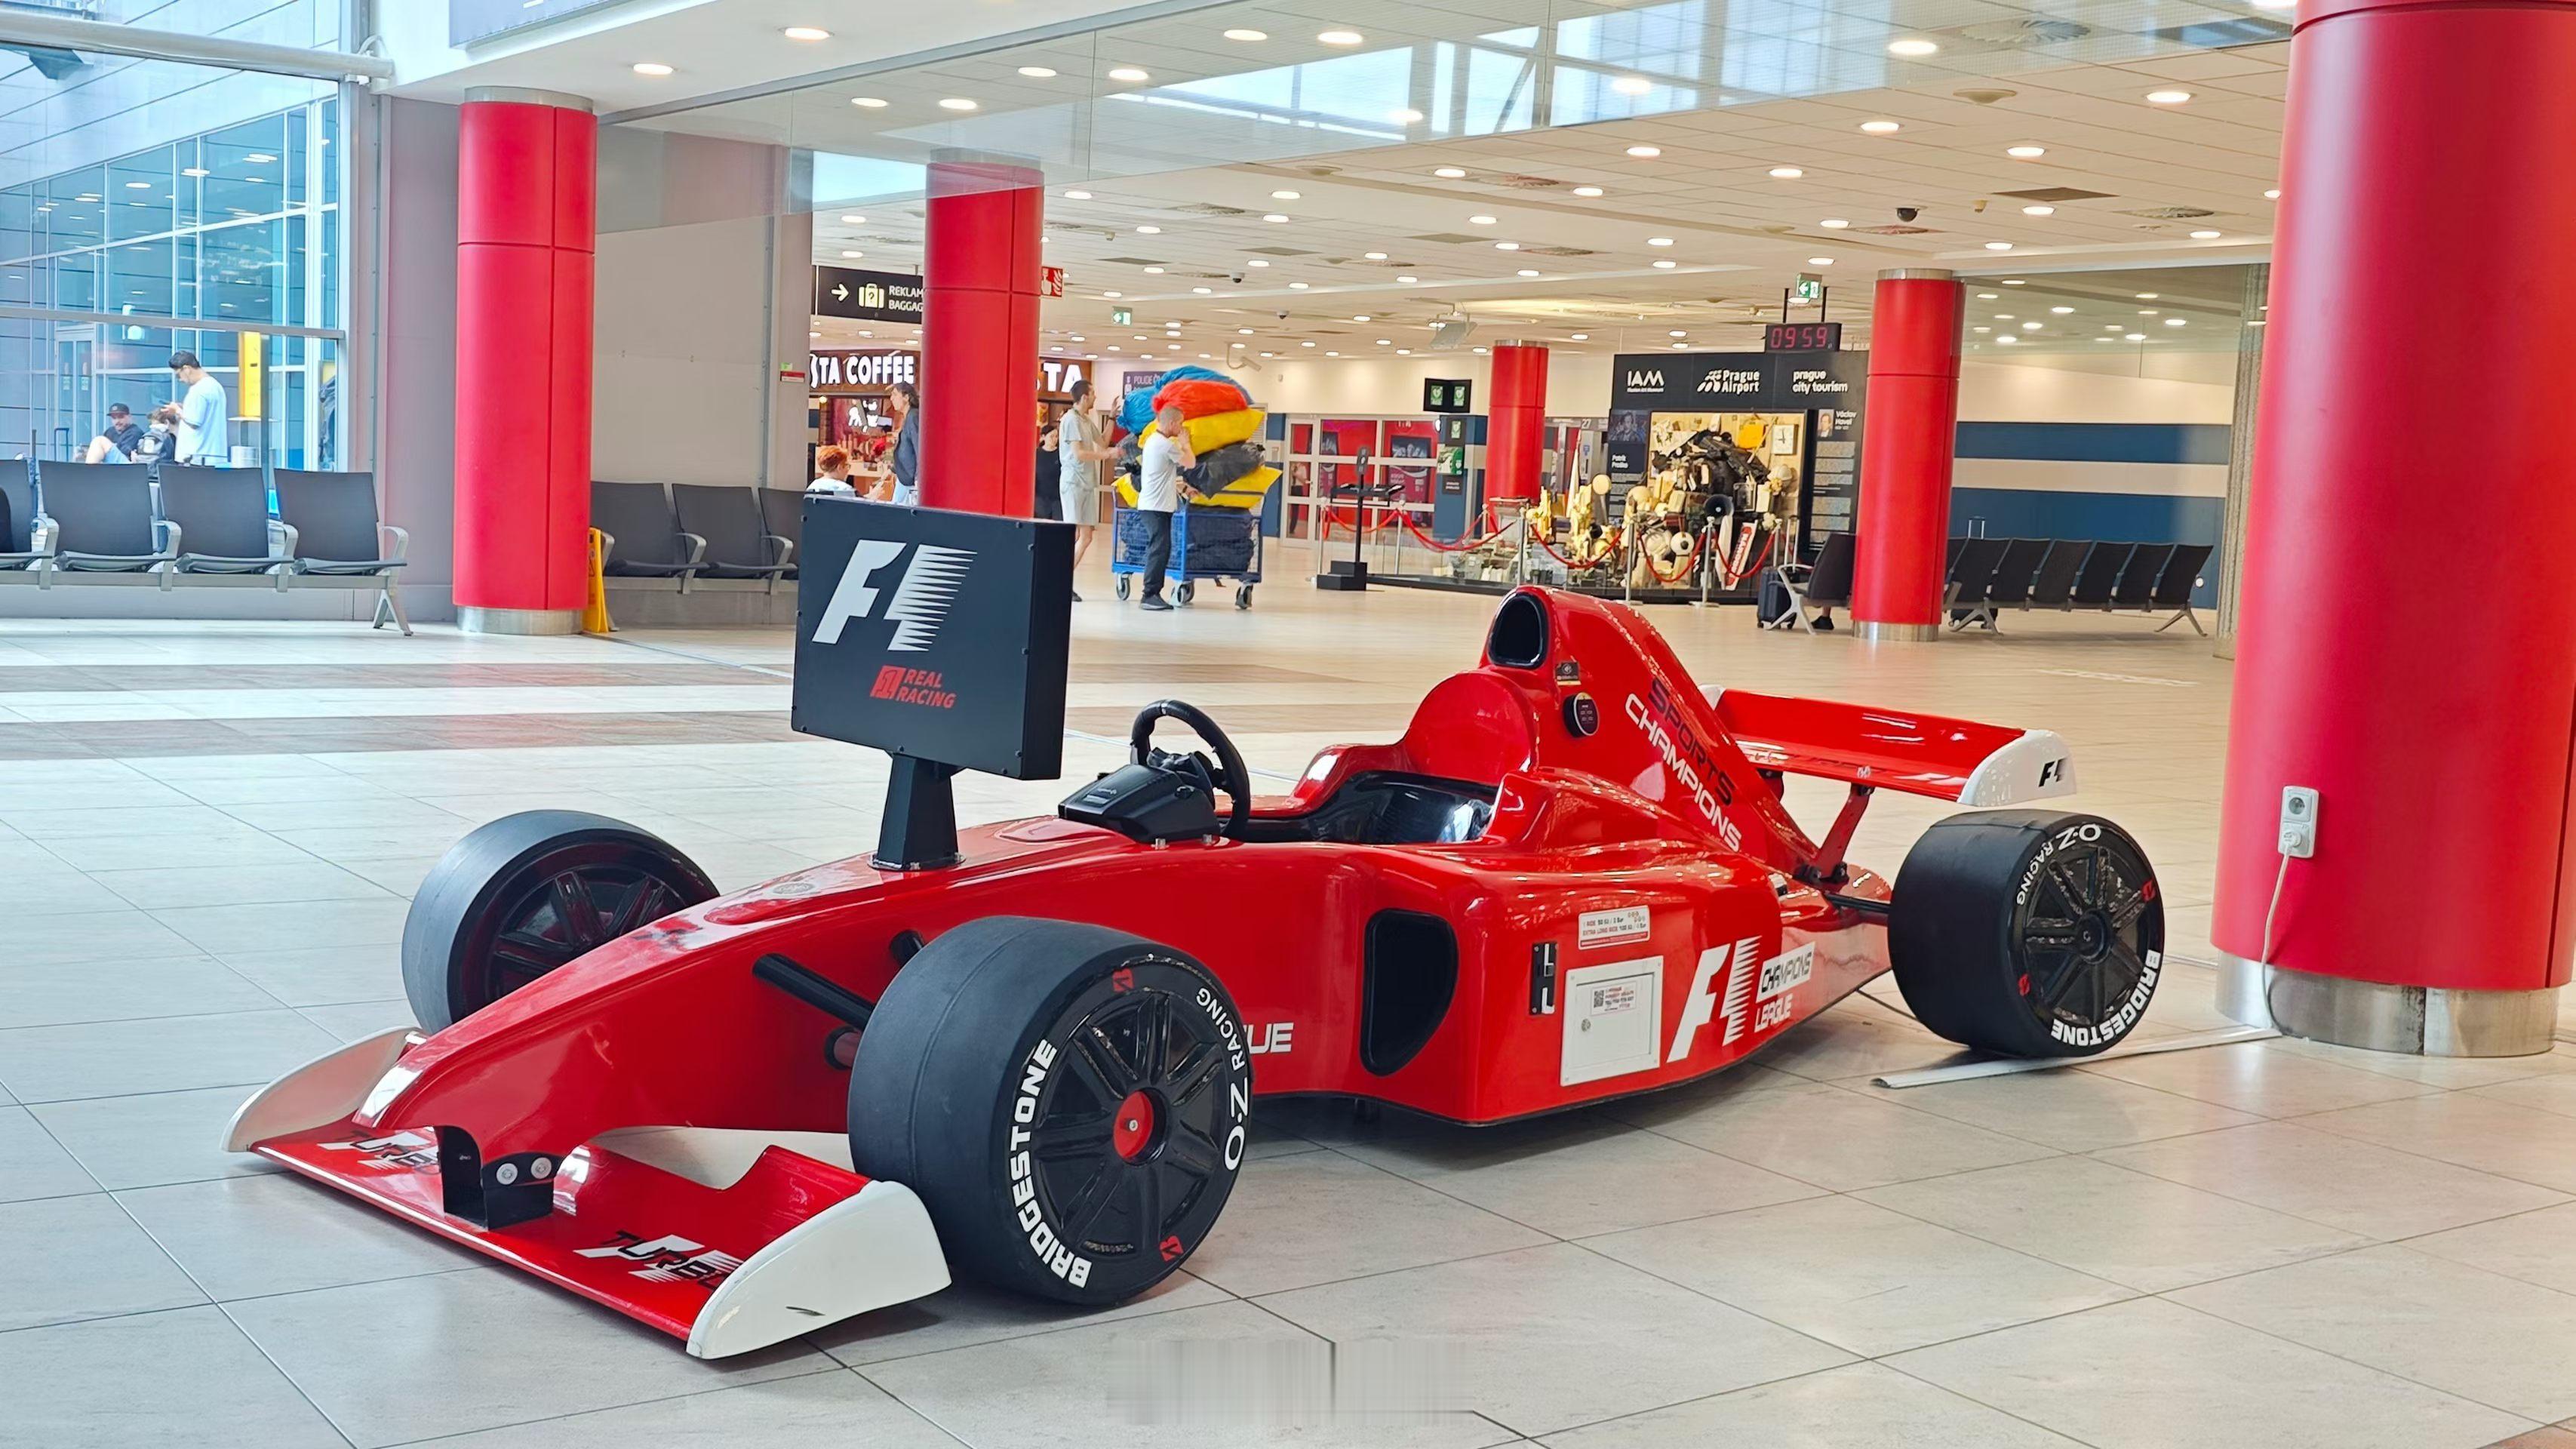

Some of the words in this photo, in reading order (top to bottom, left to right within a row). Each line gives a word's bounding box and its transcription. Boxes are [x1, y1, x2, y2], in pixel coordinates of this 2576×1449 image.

[889, 285, 924, 298] REKLAM
[889, 300, 924, 312] BAGGAG
[846, 355, 915, 385] COFFEE
[1037, 362, 1082, 392] TA
[1627, 370, 1665, 387] IAM
[1722, 369, 1760, 383] Prague
[1793, 371, 1827, 383] prague
[1721, 380, 1760, 395] Airport
[1792, 381, 1812, 395] city
[1812, 380, 1848, 392] tourism
[811, 539, 978, 652] F1
[902, 668, 942, 688] REAL
[896, 685, 957, 708] RACING
[1648, 678, 1735, 806] SPORTS
[1625, 693, 1742, 852] CHAMPIONS
[2016, 841, 2055, 906] RACING
[1666, 935, 1763, 1063] F1
[1754, 993, 1794, 1033] LEAGUE
[2051, 949, 2161, 1047] BRIDGESTONE
[1196, 986, 1246, 1071] RACING
[1243, 1023, 1294, 1054] UE
[1010, 1038, 1093, 1289] BRIDGESTONE
